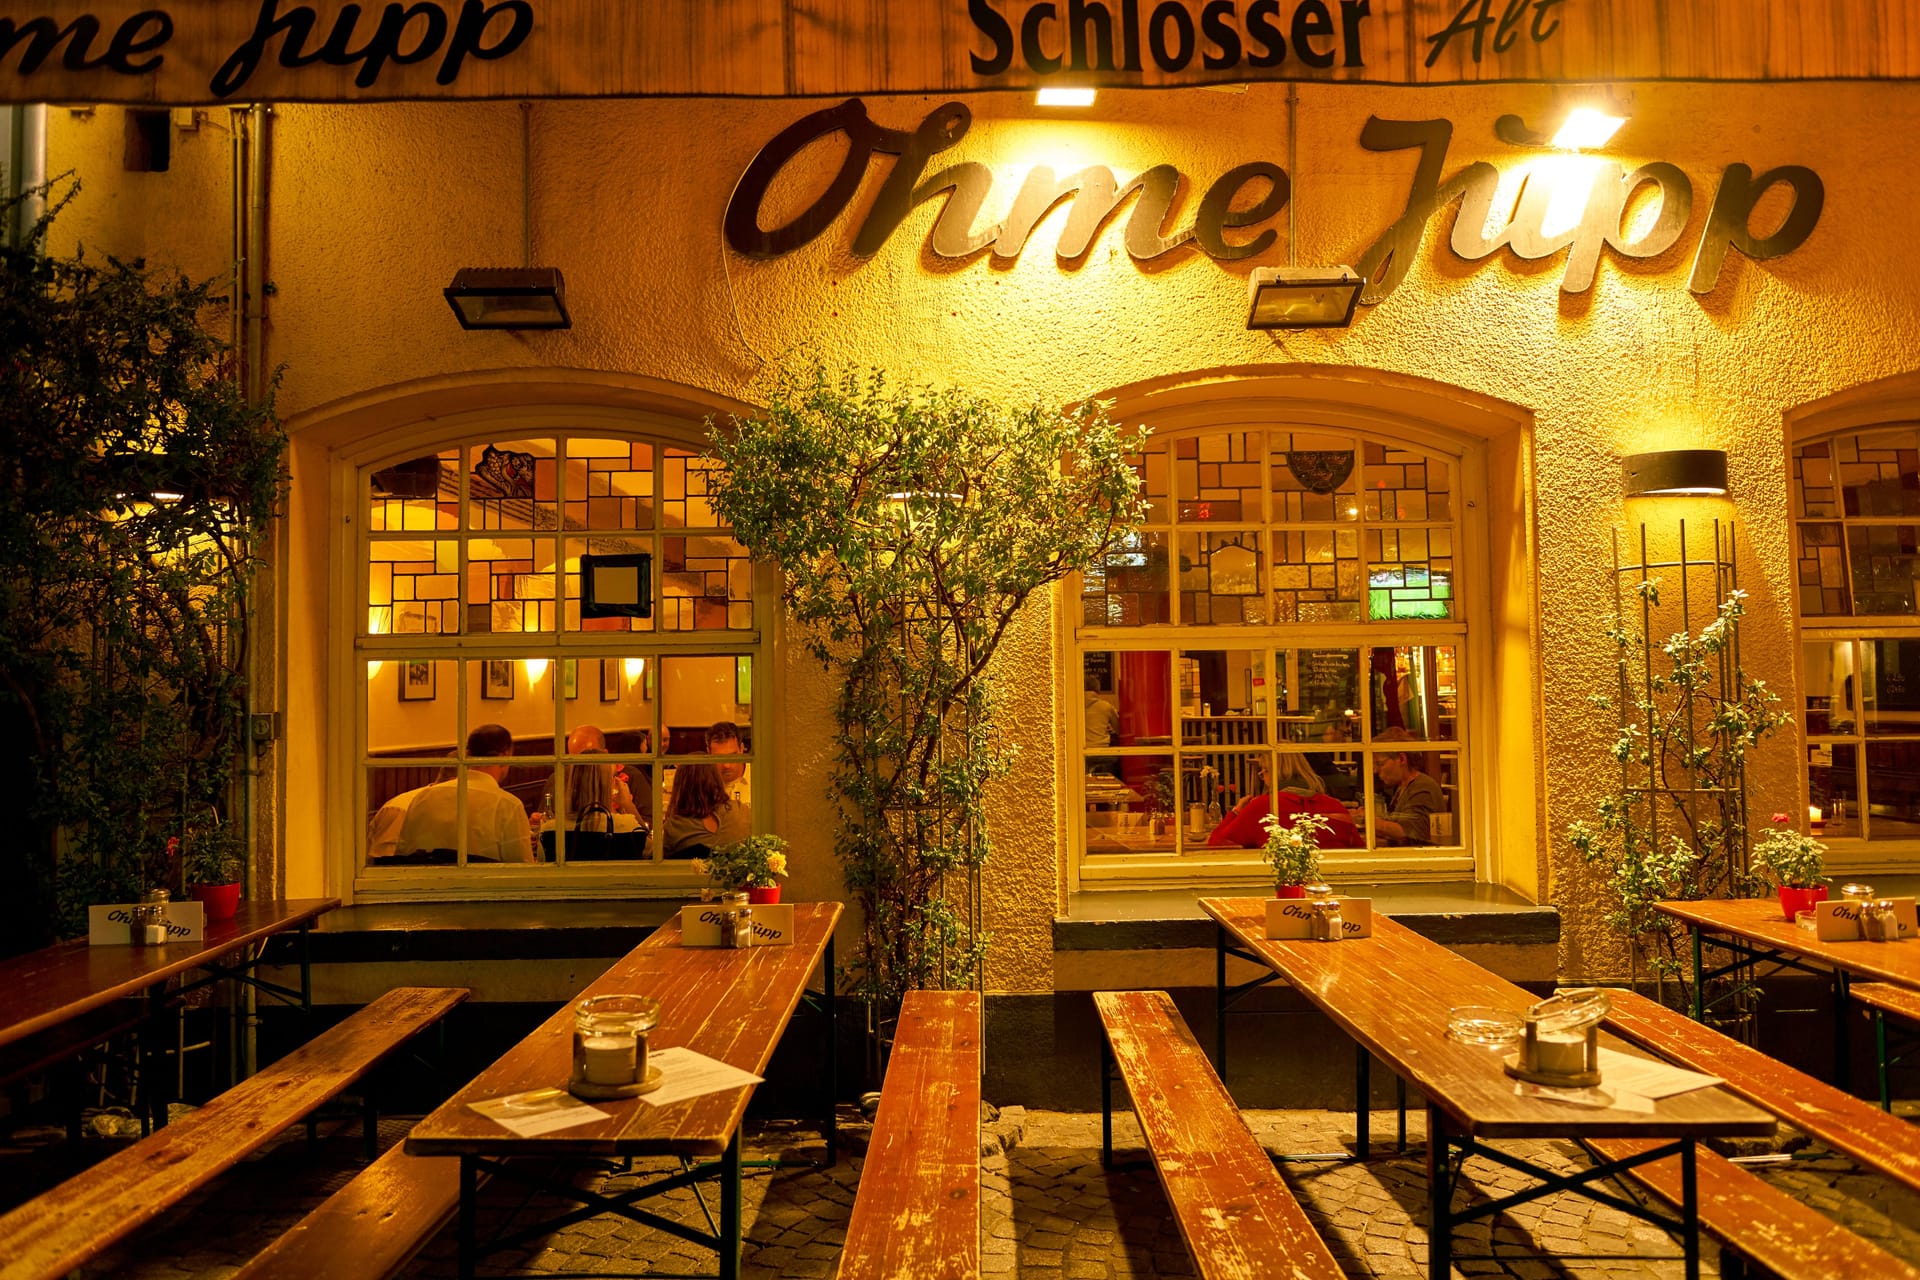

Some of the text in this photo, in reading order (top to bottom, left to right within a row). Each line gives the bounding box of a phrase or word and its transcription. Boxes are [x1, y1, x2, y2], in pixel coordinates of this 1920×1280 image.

[969, 0, 1572, 76] Schlosser Alt
[724, 97, 1292, 261] Ohme
